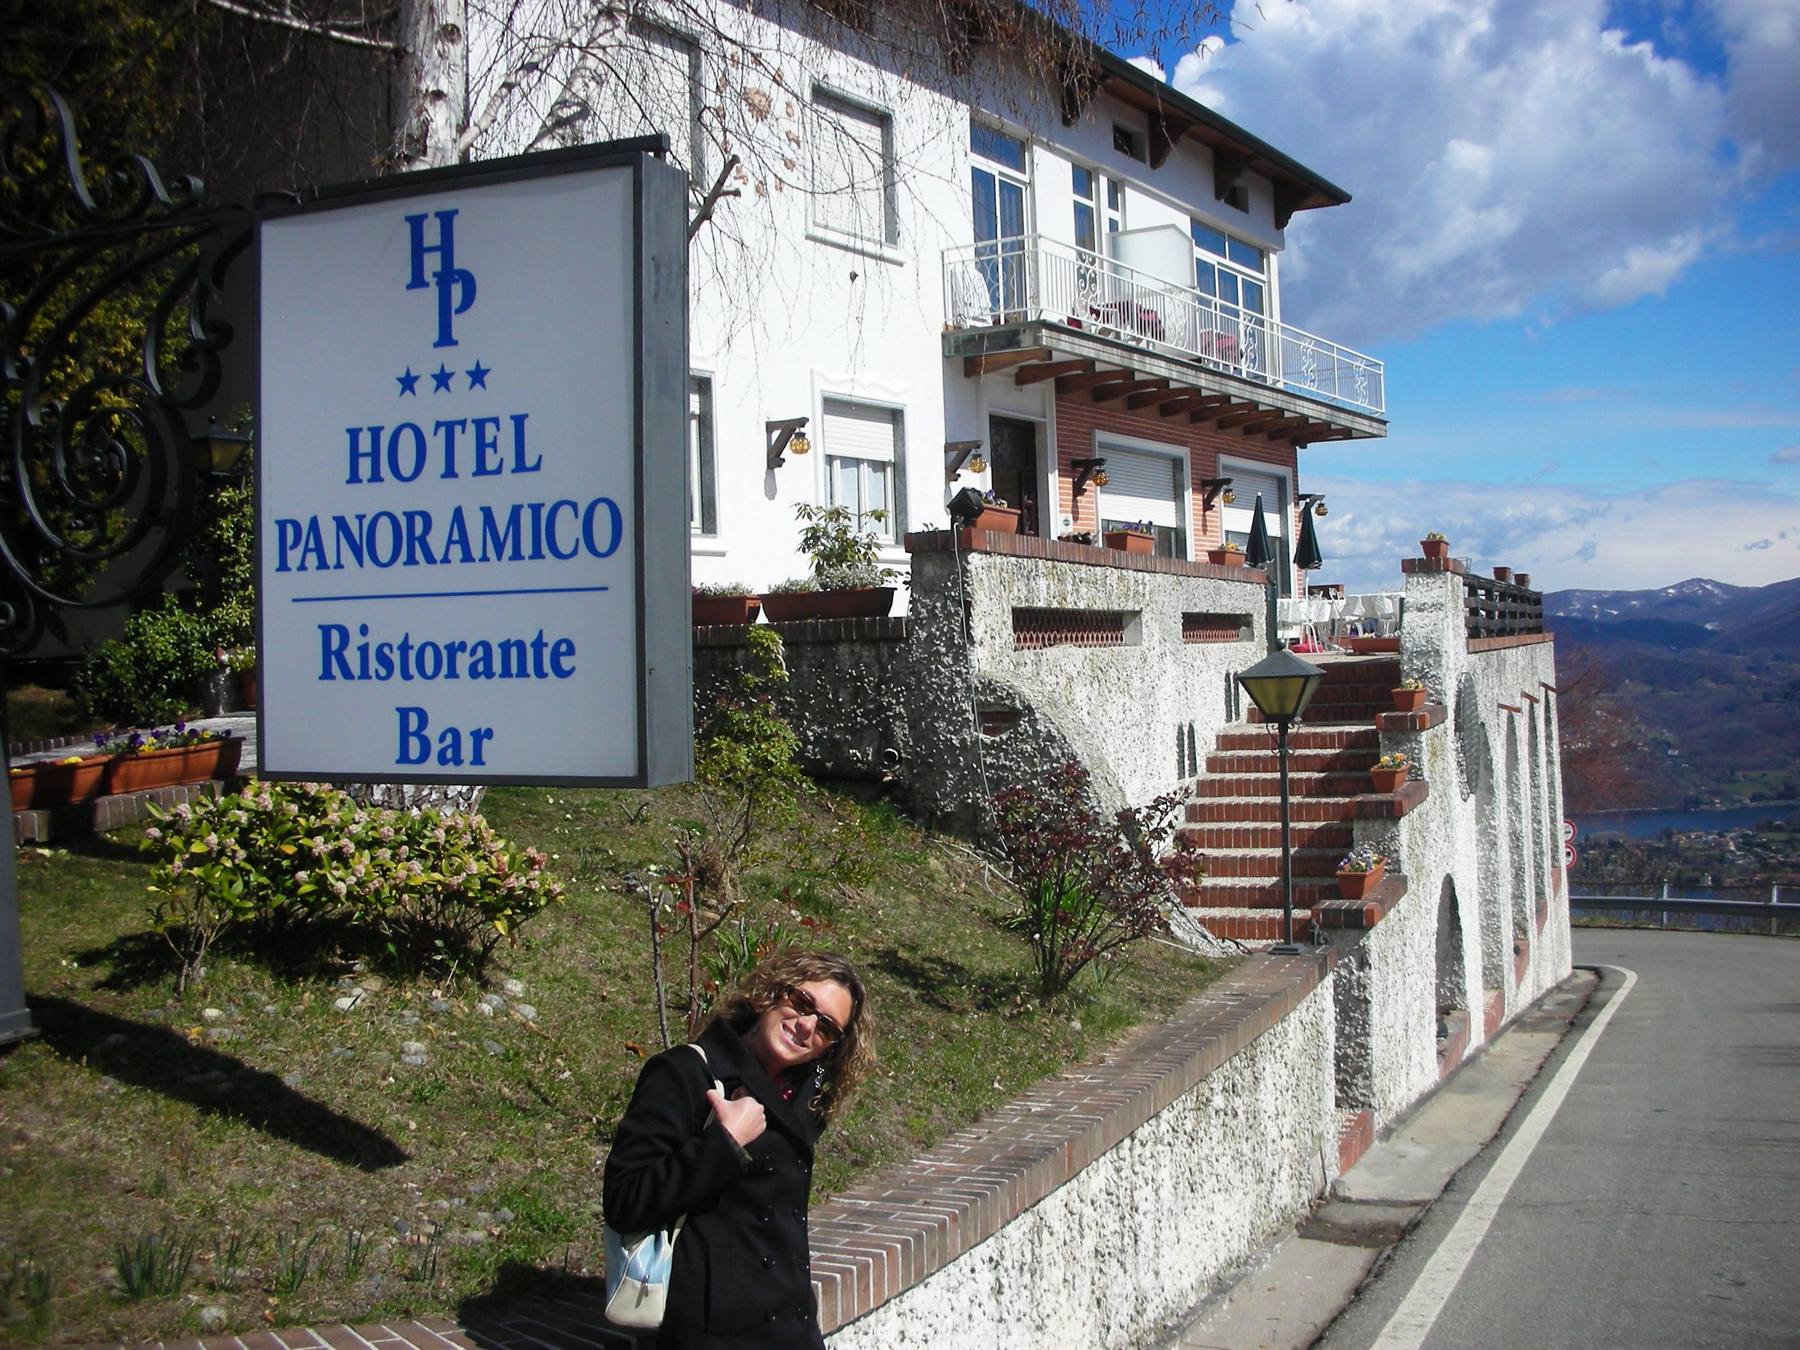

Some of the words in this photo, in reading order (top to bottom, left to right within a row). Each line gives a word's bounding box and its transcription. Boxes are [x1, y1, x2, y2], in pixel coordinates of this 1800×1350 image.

[345, 413, 542, 485] HOTEL
[274, 497, 622, 572] PANORAMICO
[317, 623, 576, 681] Ristorante
[394, 707, 493, 767] Bar
